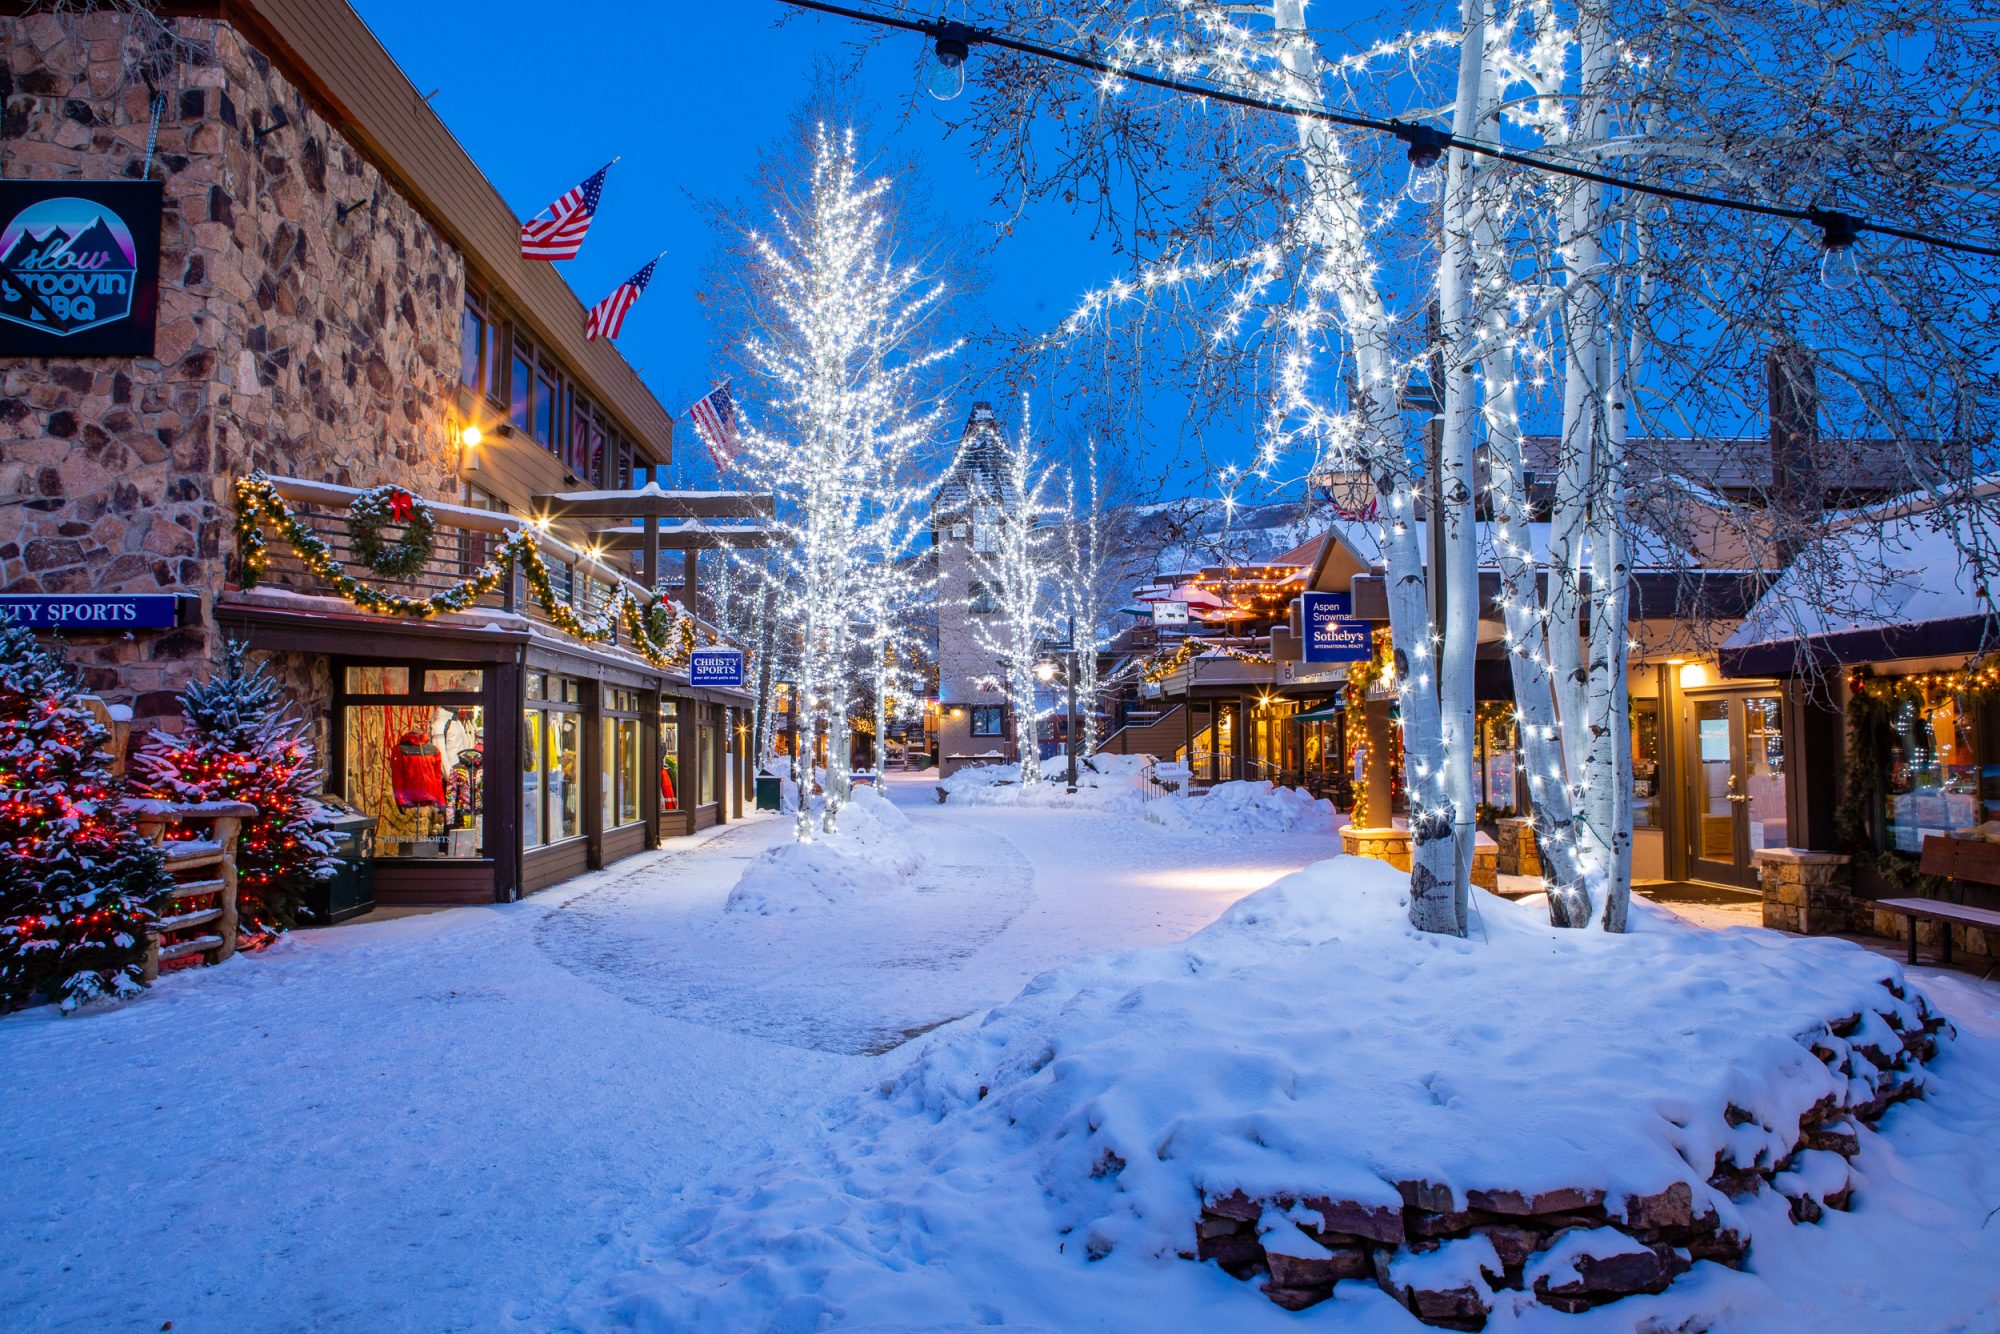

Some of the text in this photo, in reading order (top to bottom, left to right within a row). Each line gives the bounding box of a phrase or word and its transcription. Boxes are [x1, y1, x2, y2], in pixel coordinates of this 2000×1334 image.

[19, 239, 112, 270] slow
[47, 603, 137, 621] SPORTS
[1313, 602, 1339, 612] Aspen
[1313, 612, 1356, 621] Snowmas
[1314, 630, 1364, 643] Sotheby's
[694, 658, 739, 666] CHRISTY
[696, 666, 736, 674] SPORTS
